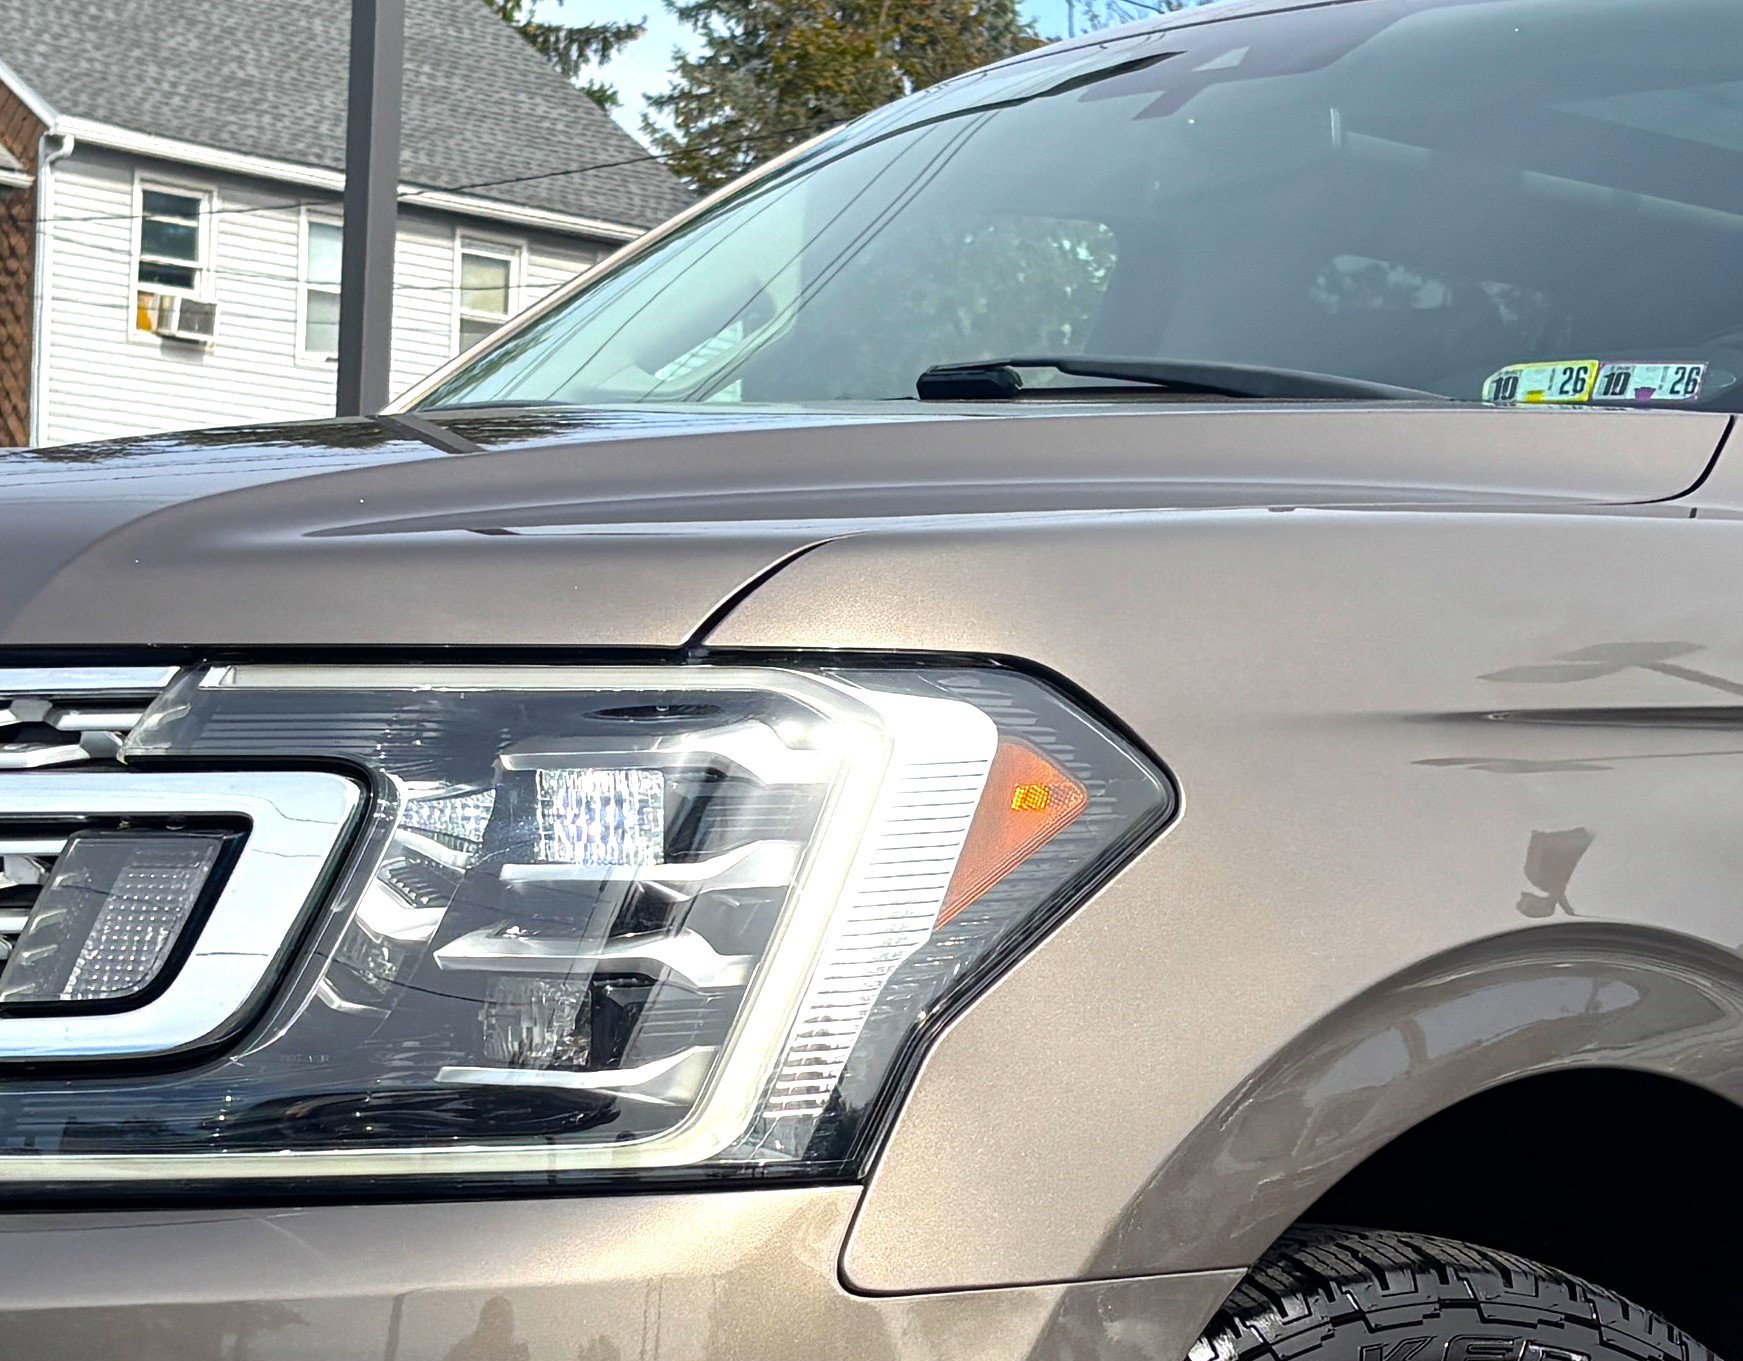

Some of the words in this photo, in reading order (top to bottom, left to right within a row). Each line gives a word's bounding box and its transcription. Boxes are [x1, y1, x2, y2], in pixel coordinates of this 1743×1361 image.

[1560, 366, 1588, 395] 26
[1602, 371, 1630, 396] 10
[1669, 367, 1699, 395] 26
